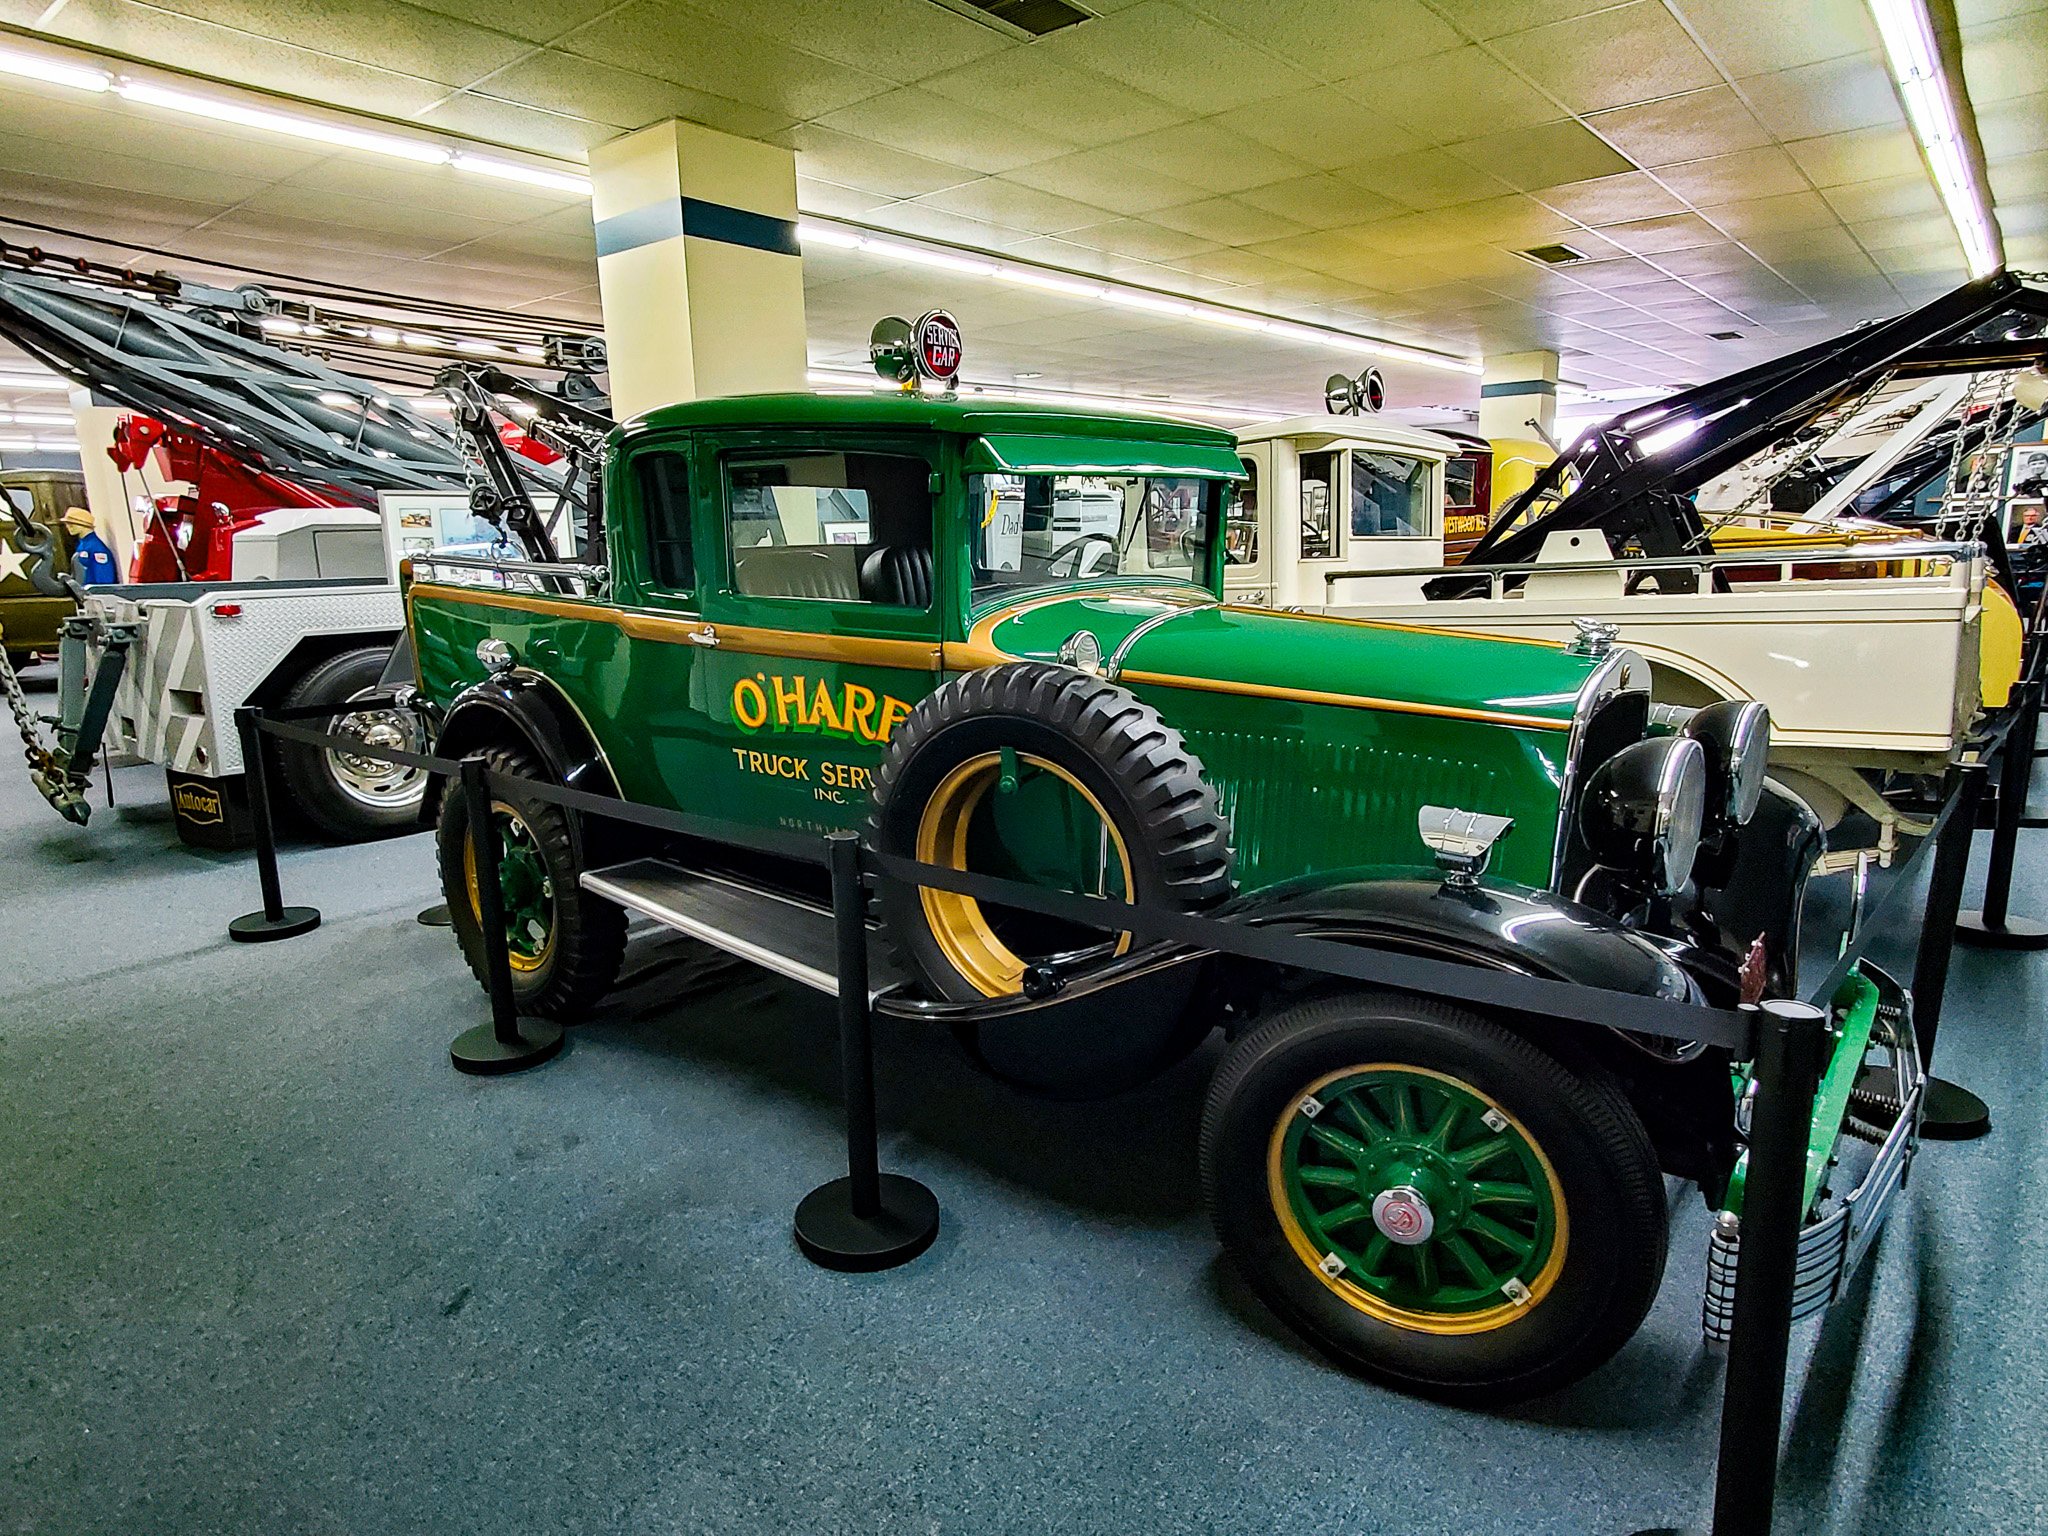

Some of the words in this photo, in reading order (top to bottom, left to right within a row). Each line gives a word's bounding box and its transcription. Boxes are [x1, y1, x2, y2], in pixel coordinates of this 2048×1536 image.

[932, 345, 956, 368] CAR
[732, 747, 810, 781] TRUCK
[177, 790, 218, 814] Autocar
[813, 787, 850, 805] INC.
